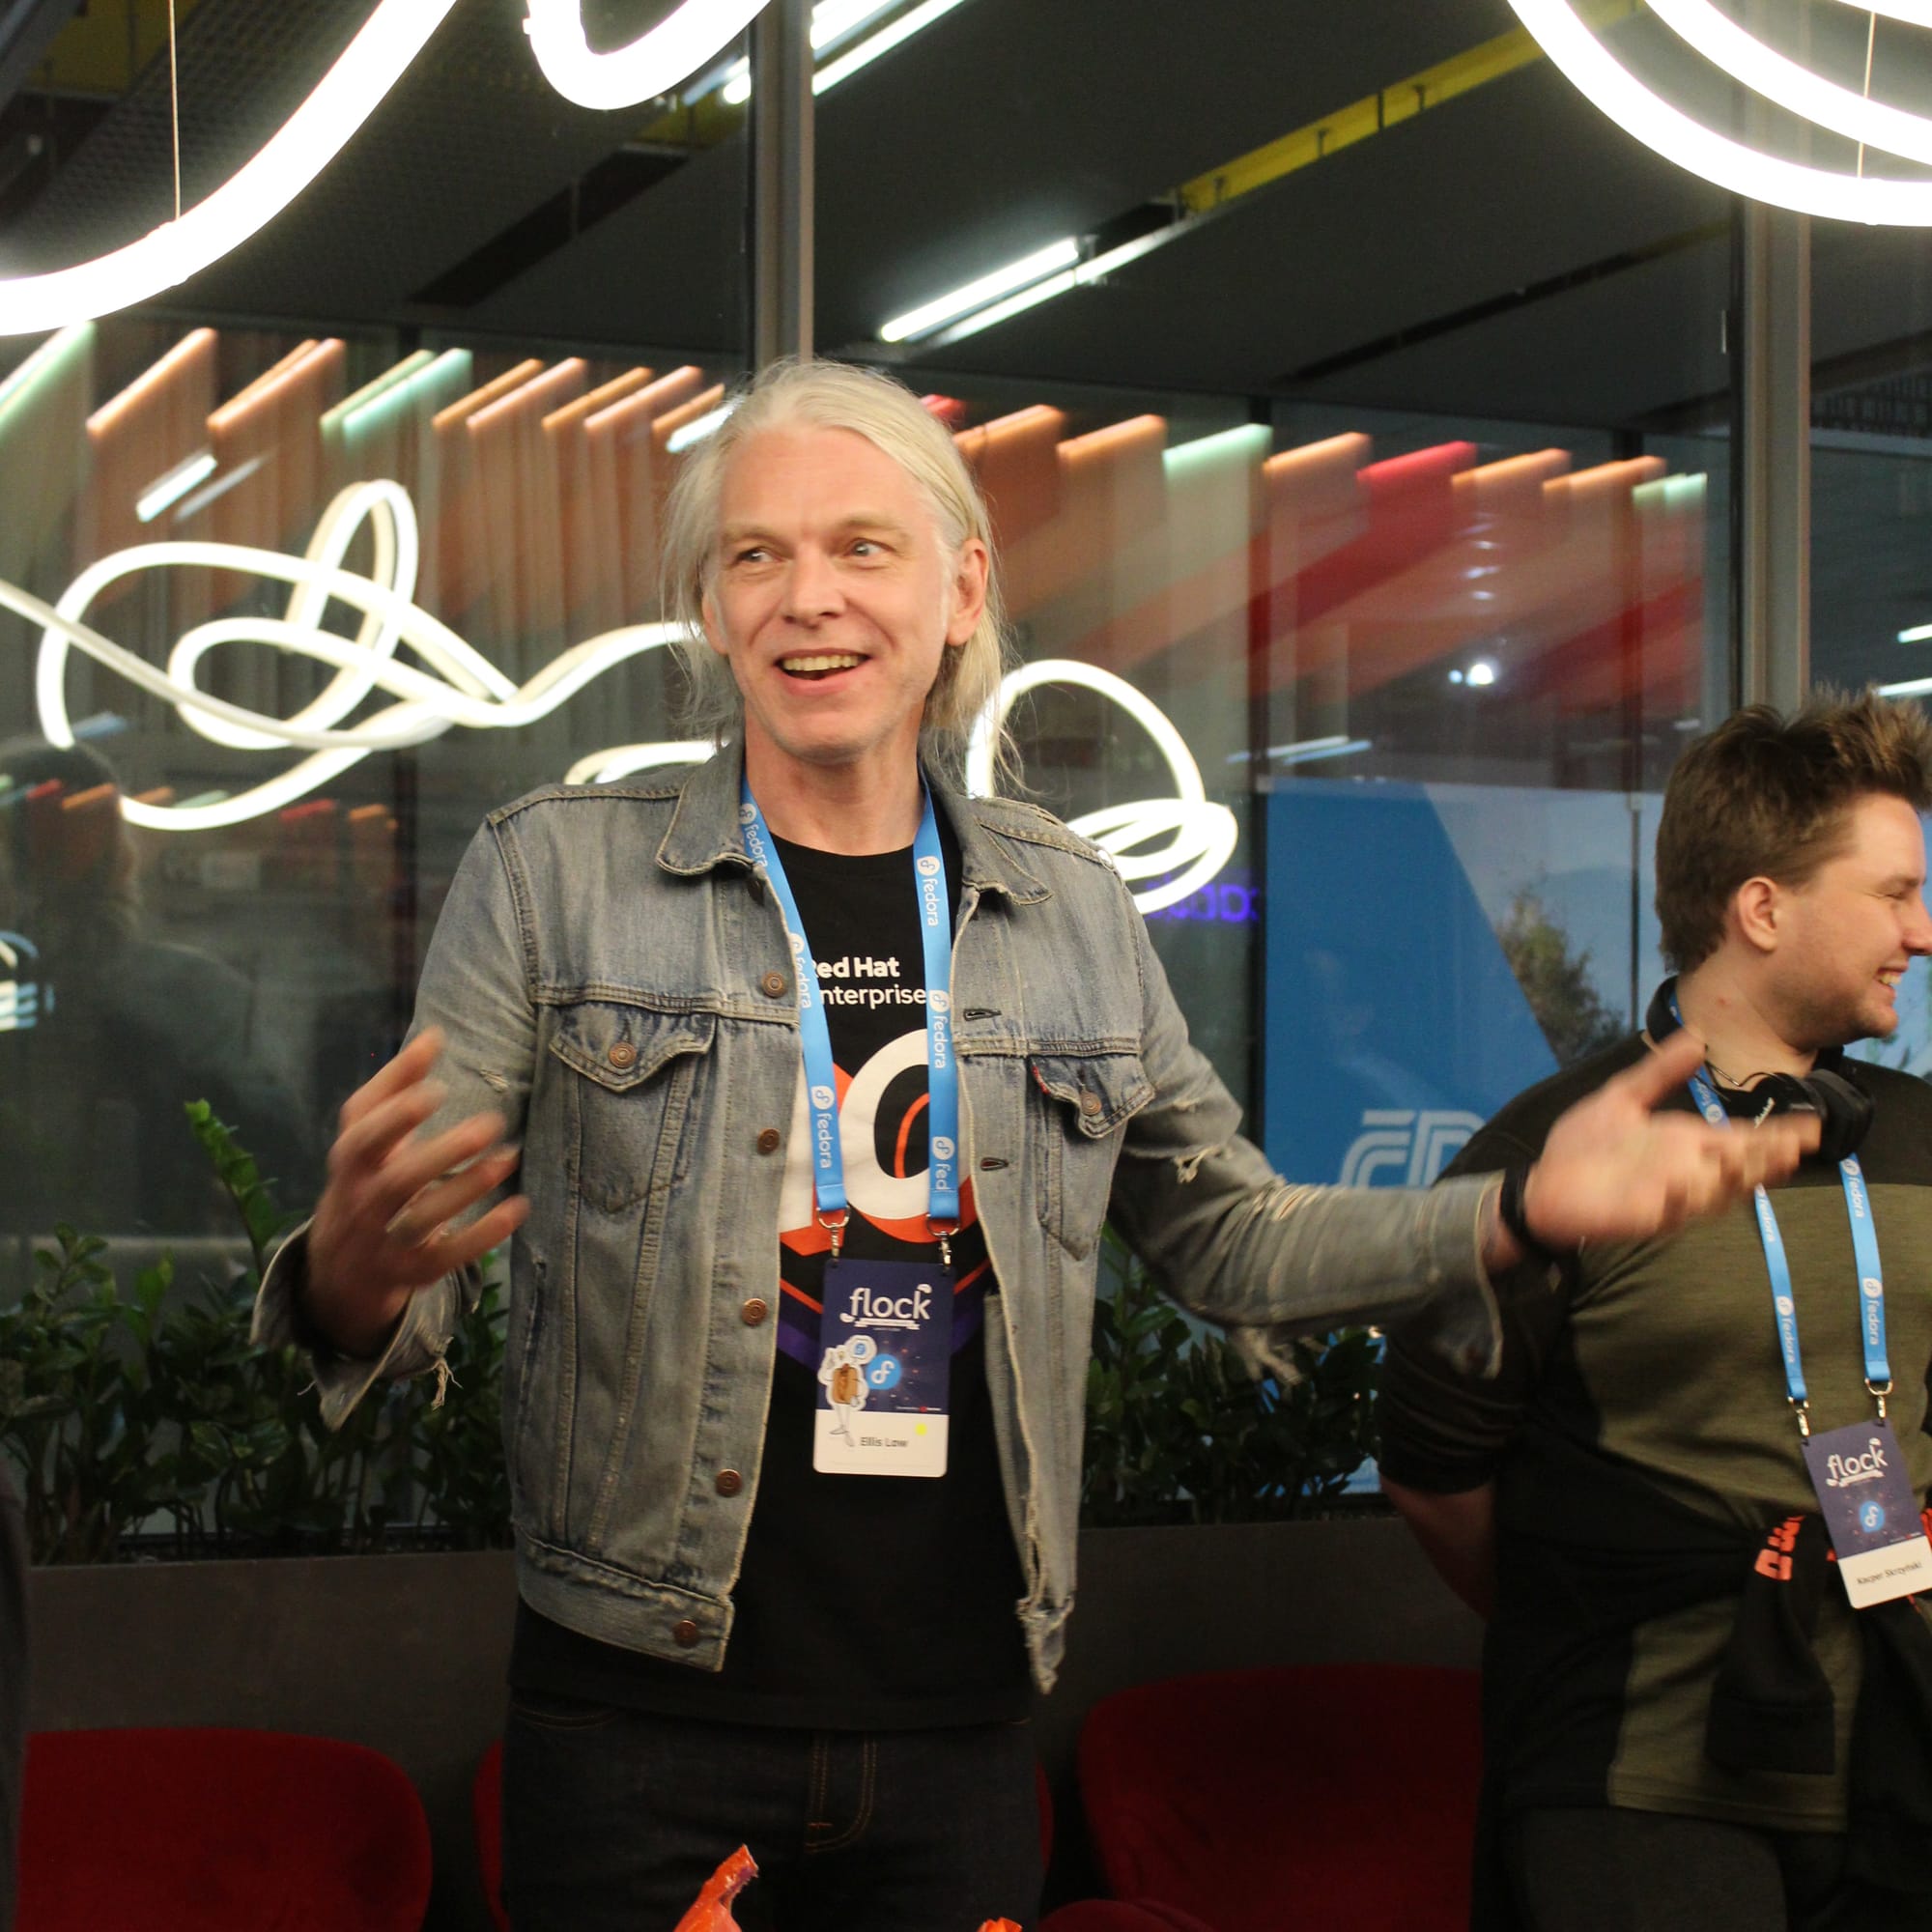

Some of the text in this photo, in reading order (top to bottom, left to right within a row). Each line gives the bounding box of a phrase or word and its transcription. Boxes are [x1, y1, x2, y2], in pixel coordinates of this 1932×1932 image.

[745, 824, 768, 867] fedora
[923, 878, 939, 927] fedora
[811, 956, 900, 979] ed Hat
[819, 983, 926, 1009] nterprise
[933, 1015, 949, 1069] fedora
[816, 1113, 834, 1169] fedora
[1759, 1197, 1775, 1243] fedora
[1849, 1177, 1865, 1219] fedora
[839, 1283, 932, 1323] flock
[1866, 1299, 1880, 1346] fedora
[1781, 1317, 1796, 1364] fedora
[1826, 1437, 1888, 1484] flock
